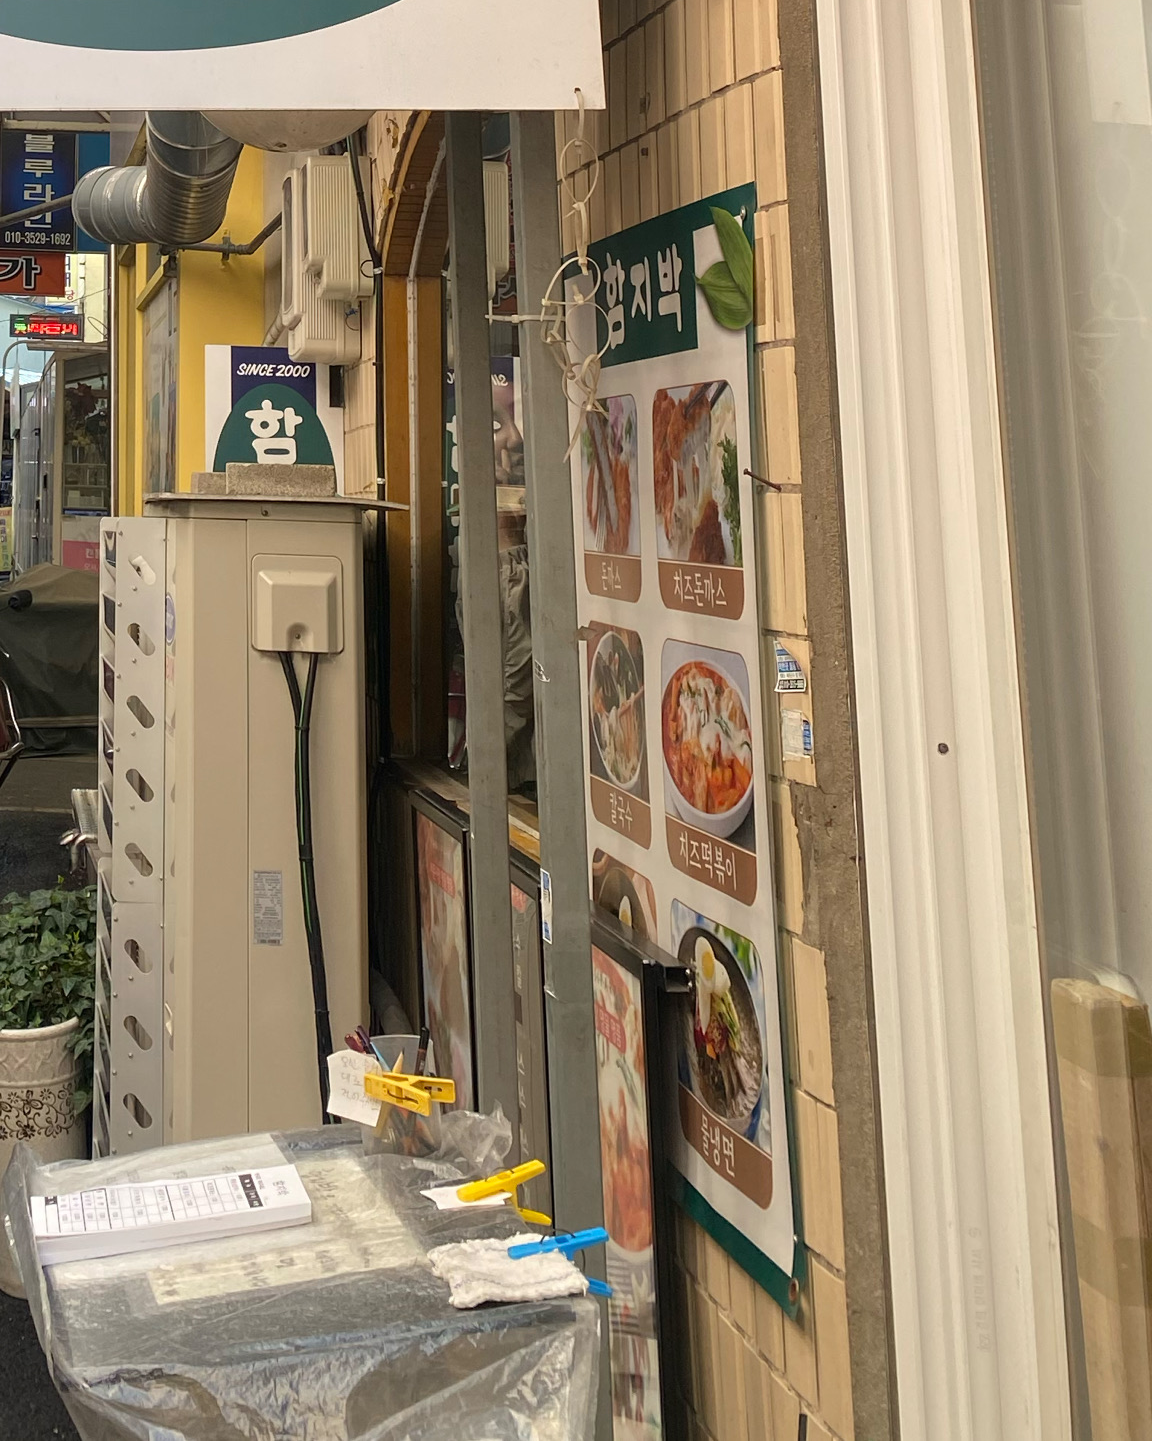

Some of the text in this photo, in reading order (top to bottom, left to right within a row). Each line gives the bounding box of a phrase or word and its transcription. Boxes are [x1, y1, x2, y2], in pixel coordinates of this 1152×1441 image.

[4, 231, 71, 246] 010-3529-1692
[603, 243, 683, 350] 함지박
[237, 363, 310, 377] SINCE 2000
[245, 399, 303, 465] 함
[601, 560, 622, 592] 돈까스
[673, 568, 727, 608] 치즈돈까스
[609, 792, 633, 832] 칼국수
[679, 831, 737, 891] 치즈떡볶이
[701, 1111, 735, 1178] 물냉면
